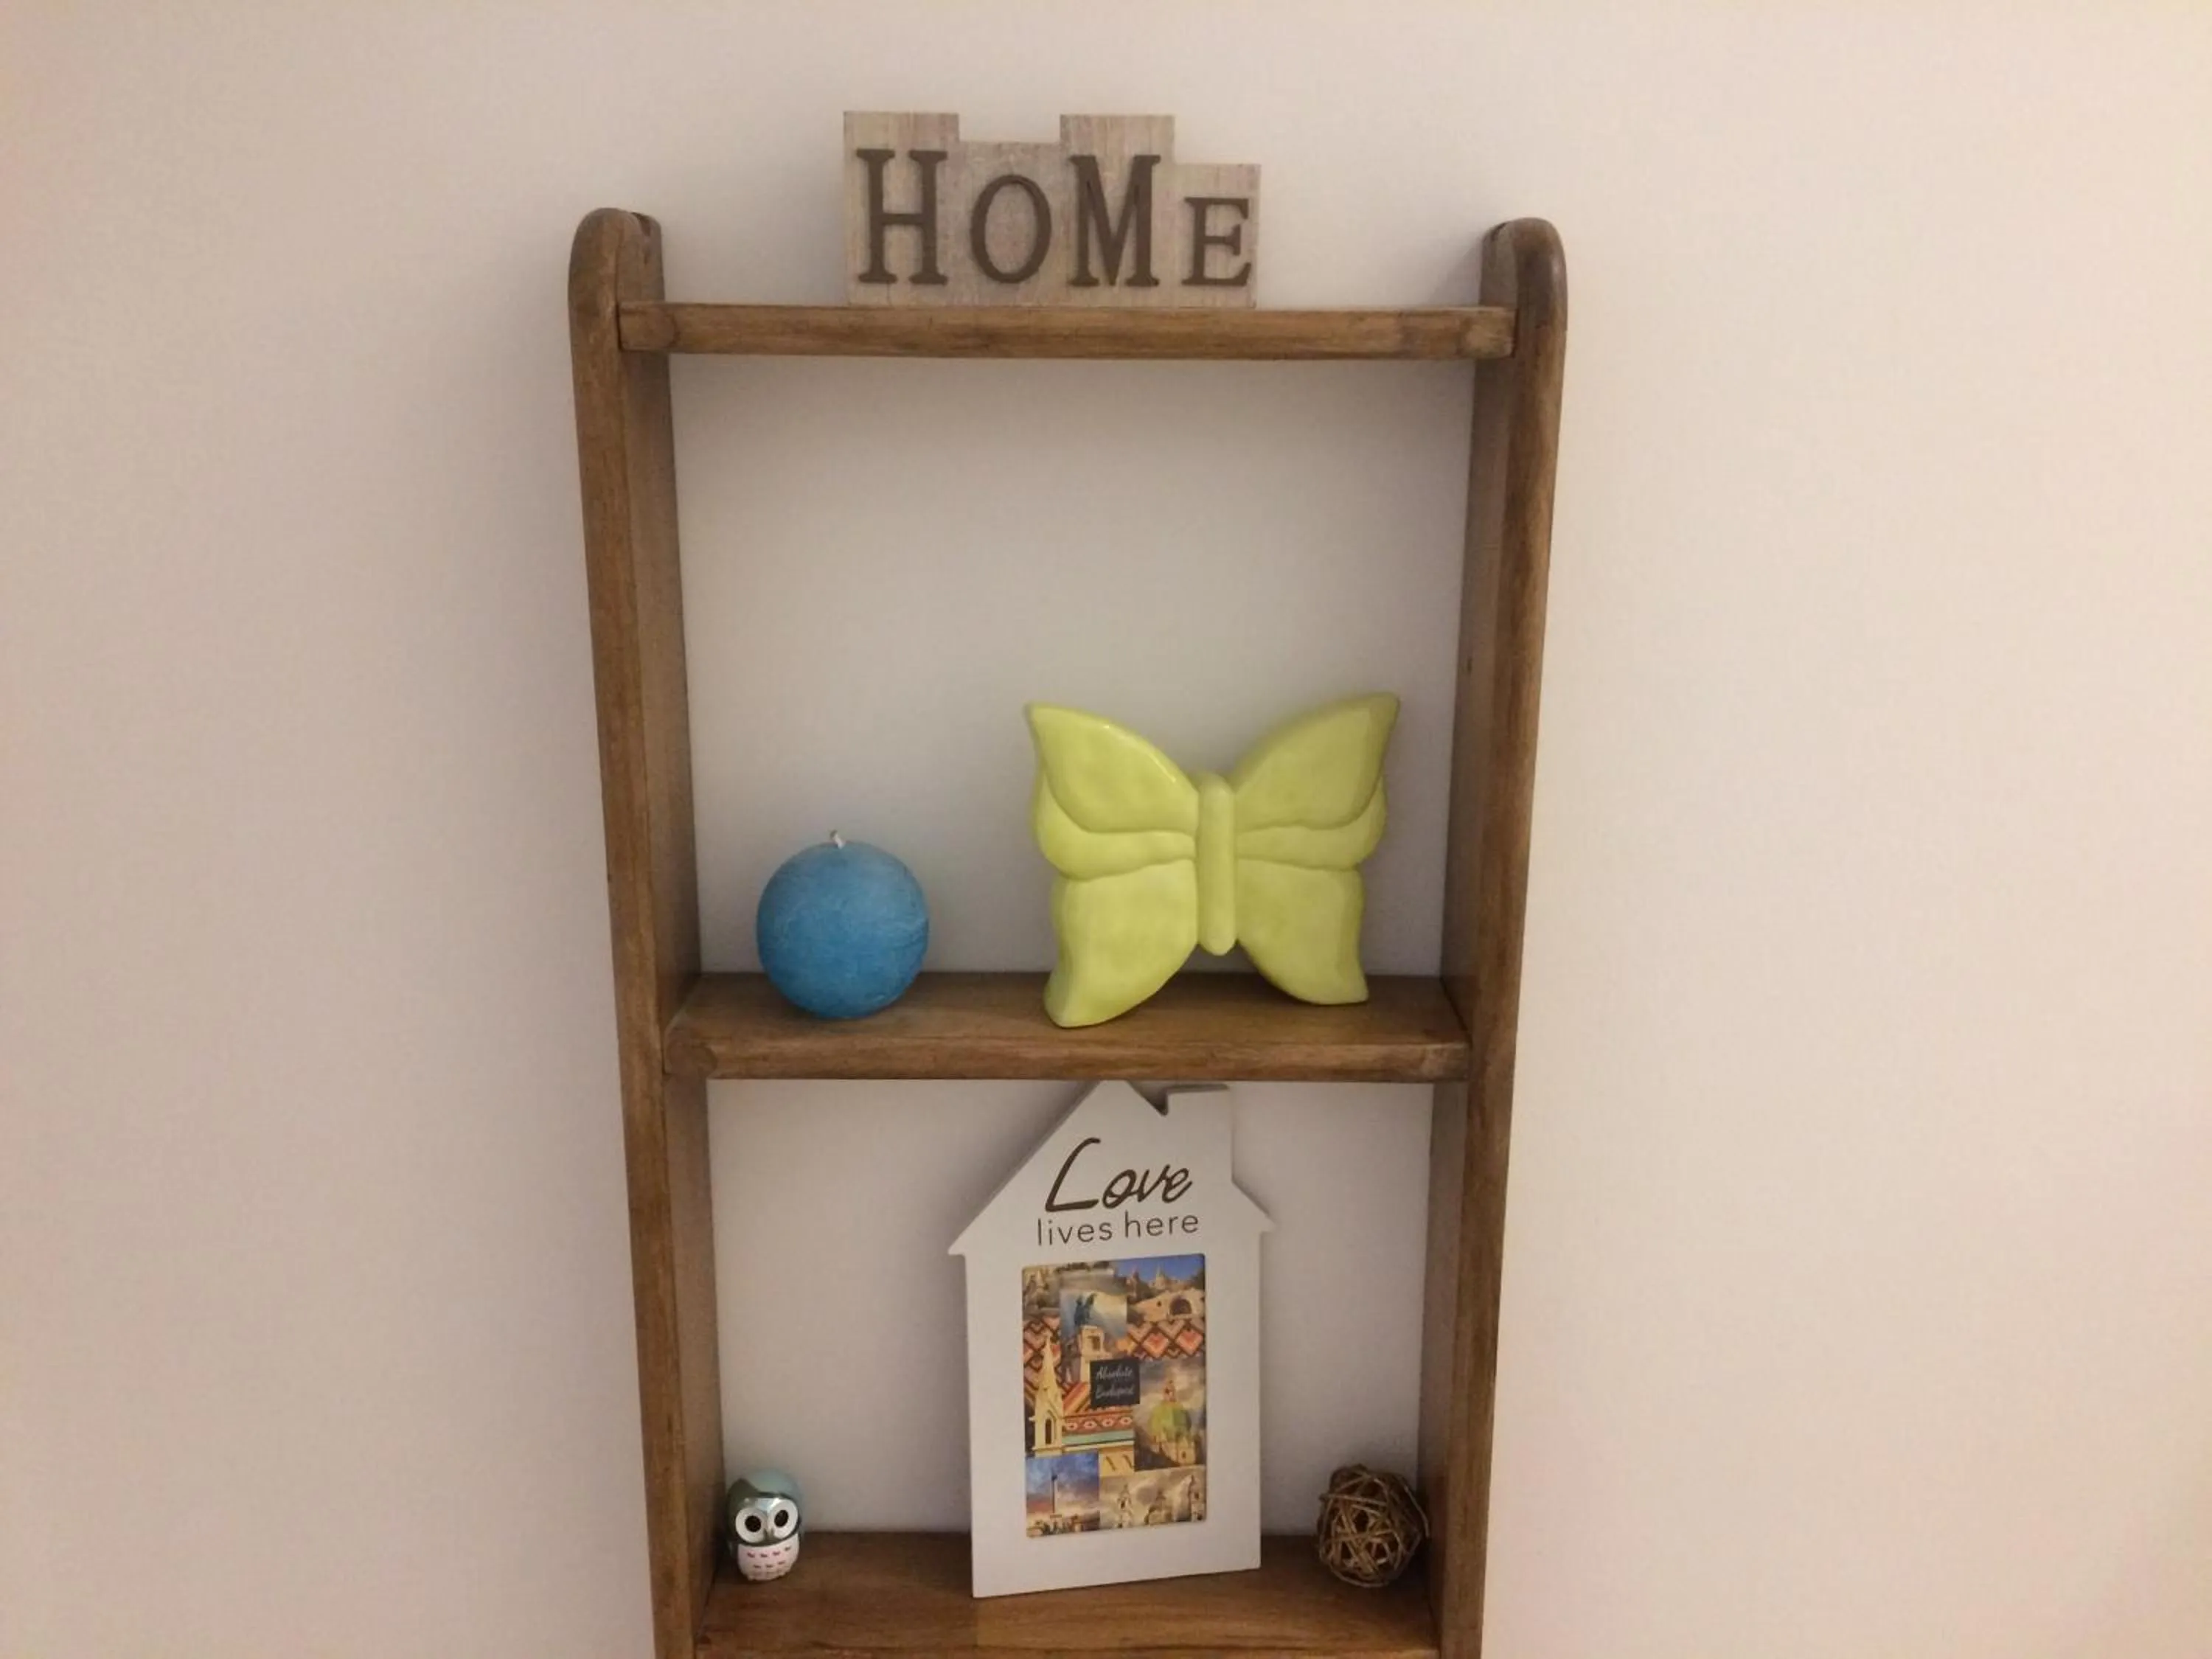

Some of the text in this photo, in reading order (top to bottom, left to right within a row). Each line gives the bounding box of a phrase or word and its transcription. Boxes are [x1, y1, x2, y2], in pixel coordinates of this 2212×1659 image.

[856, 148, 1253, 287] HOME
[1045, 1137, 1193, 1212] Love
[1037, 1210, 1199, 1246] lives here
